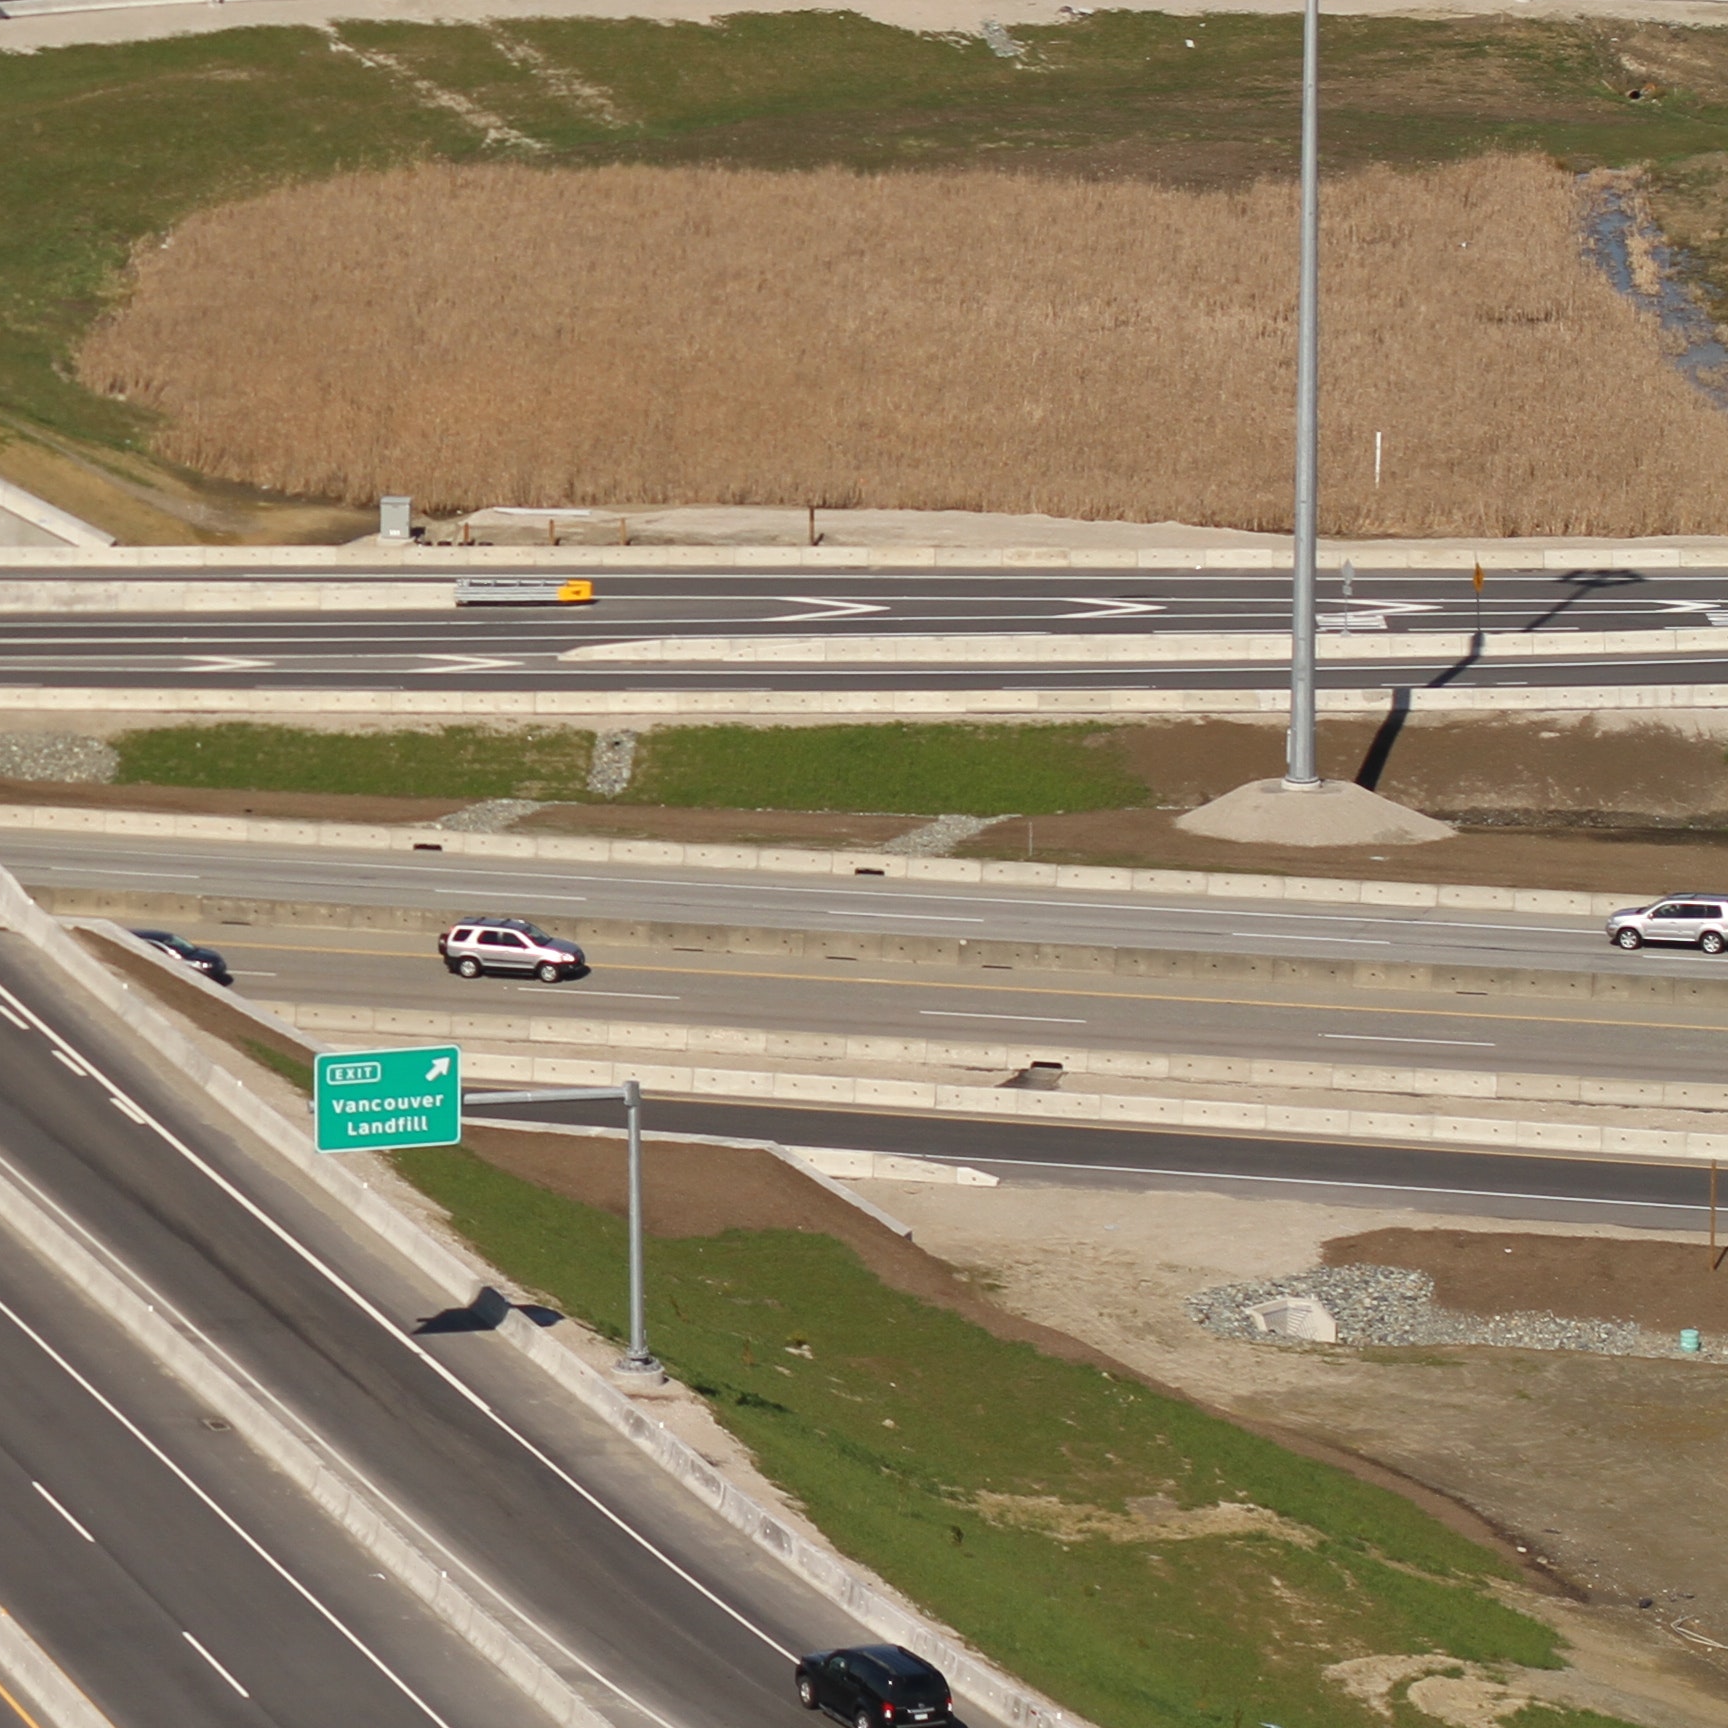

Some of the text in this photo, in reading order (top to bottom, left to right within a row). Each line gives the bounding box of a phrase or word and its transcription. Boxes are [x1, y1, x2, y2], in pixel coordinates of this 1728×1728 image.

[335, 1067, 373, 1081] EXIT
[332, 1094, 444, 1114] Vancouver
[347, 1116, 428, 1136] Landfill
